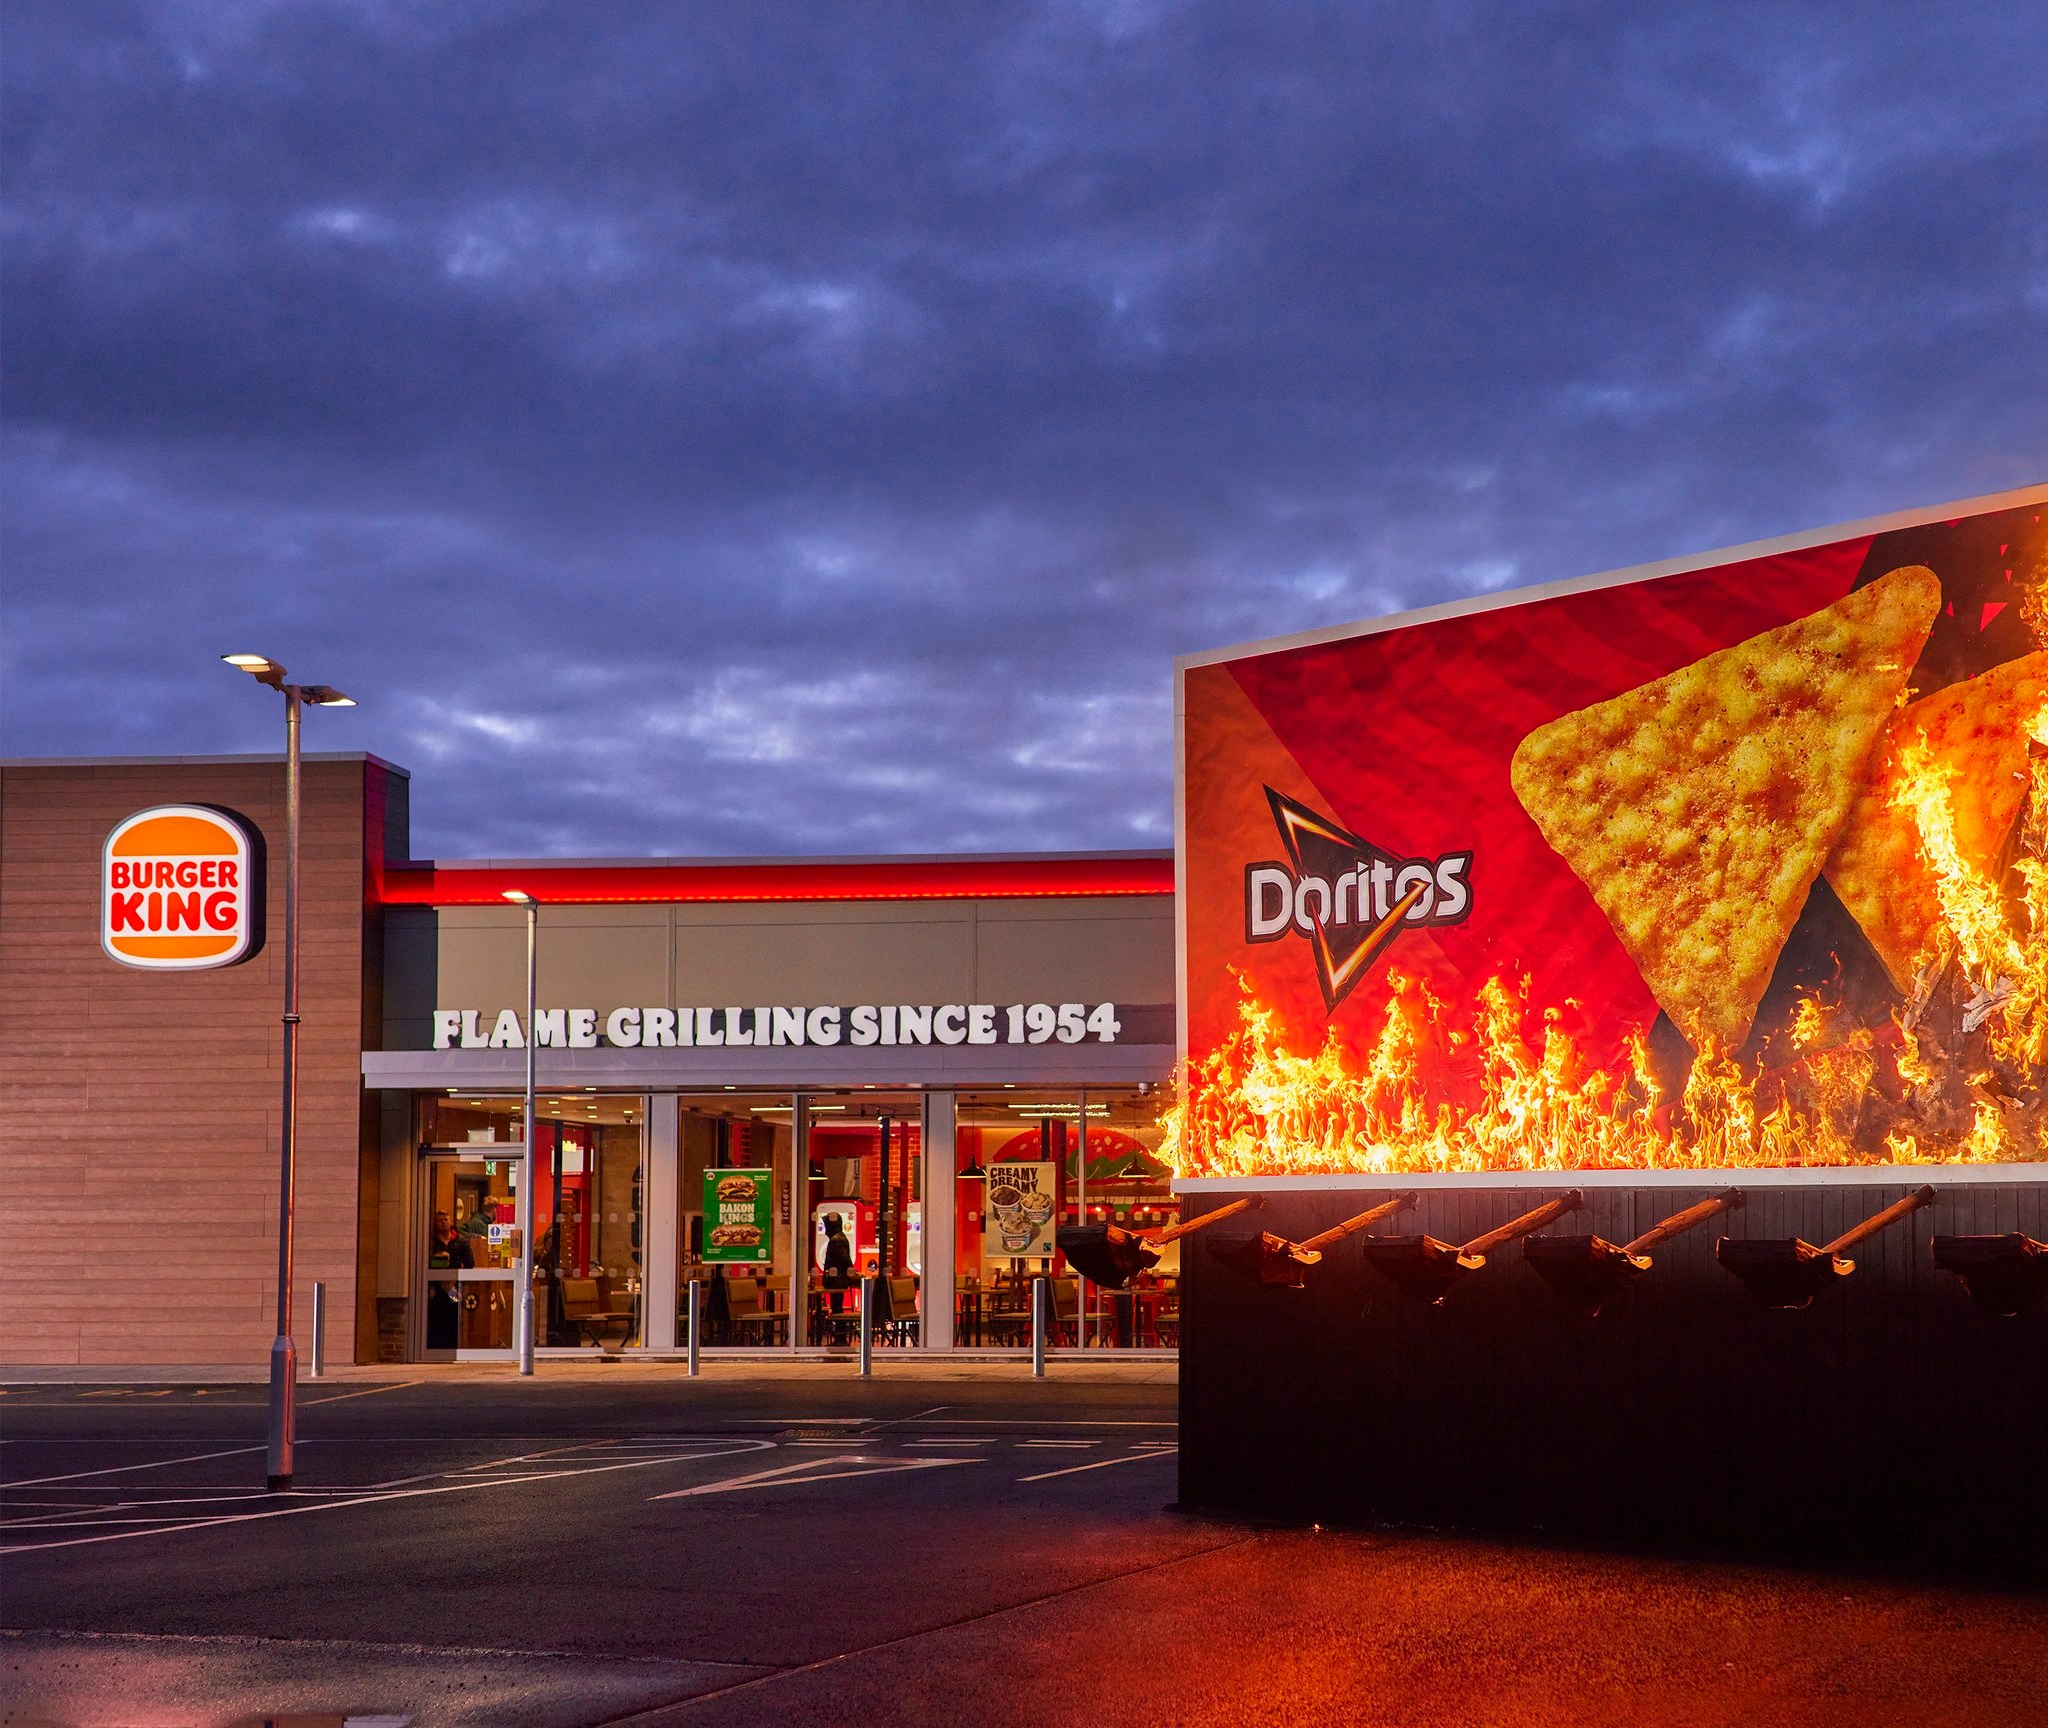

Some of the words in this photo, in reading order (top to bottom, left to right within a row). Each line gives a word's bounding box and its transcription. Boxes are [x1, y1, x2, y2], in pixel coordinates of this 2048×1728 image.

[111, 861, 238, 889] BURGER
[1250, 857, 1467, 936] Doritos
[111, 891, 238, 932] KING
[433, 1008, 598, 1049] FLAME
[606, 1006, 841, 1048] GRILLING
[850, 1004, 998, 1046] SINCE
[1006, 1002, 1121, 1044] 1954
[990, 1167, 1038, 1181] CREAMY
[990, 1176, 1038, 1194] DREAMY
[719, 1203, 755, 1213] BAKON
[719, 1213, 755, 1224] KINGS
